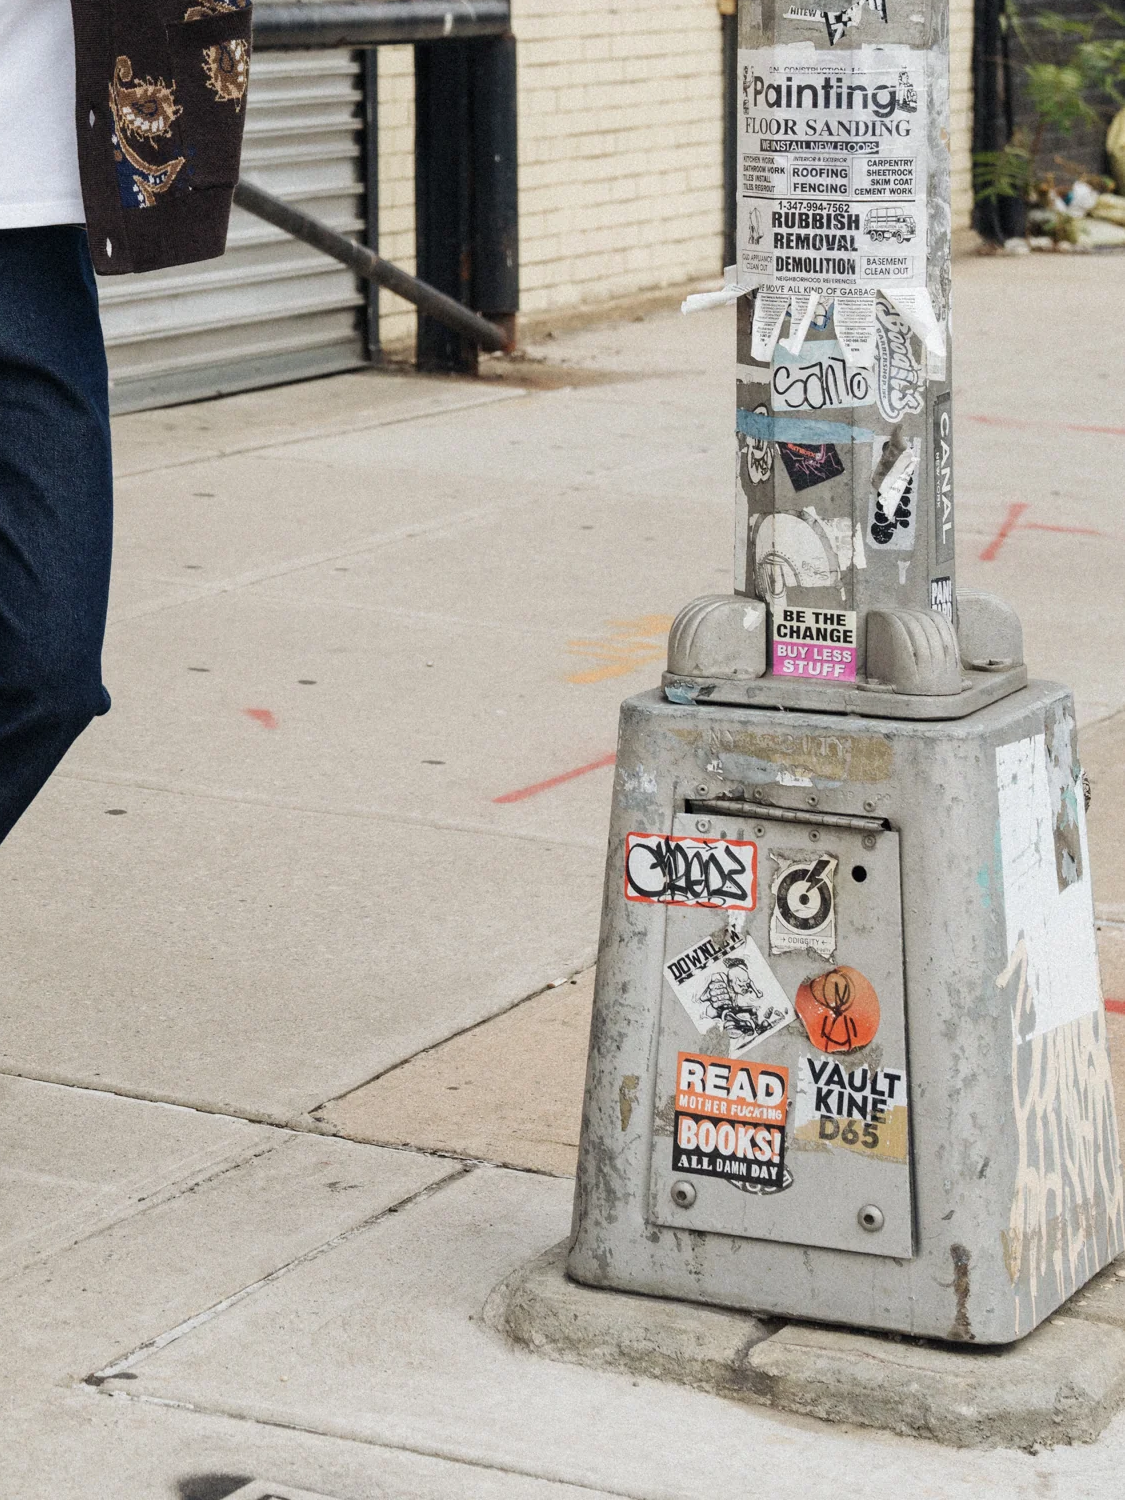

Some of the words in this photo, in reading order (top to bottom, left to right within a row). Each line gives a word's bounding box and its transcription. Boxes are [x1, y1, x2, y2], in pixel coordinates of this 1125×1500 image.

[753, 75, 897, 118] Painting
[745, 116, 798, 136] FLOOR
[804, 118, 911, 137] SANDING
[761, 140, 770, 150] WE
[771, 140, 810, 151] INSTALL
[810, 141, 835, 151] NEW
[743, 165, 766, 174] BATHROOM
[767, 166, 786, 175] WORK
[867, 159, 914, 167] CARPENTRY
[743, 174, 754, 182] TILES
[755, 174, 772, 183] INSTALL
[792, 167, 848, 179] ROOFING
[866, 168, 913, 177] SHEETROCK
[793, 182, 848, 194] FENCING
[870, 178, 891, 186] SKIM
[893, 178, 914, 186] COAT
[854, 187, 887, 196] CEMENT
[888, 187, 913, 195] WORK
[778, 200, 851, 213] 1-347-994-7562
[771, 211, 860, 231] RUBBISH
[773, 232, 859, 251] REMOVAL
[751, 253, 773, 263] APPLIANCE
[776, 256, 856, 275] DEMOLITION
[866, 257, 908, 266] BASEMENT
[775, 275, 821, 284] NEIGHBORHOOD
[822, 277, 857, 285] REFERENCES
[864, 267, 891, 276] CLEAN
[893, 267, 909, 275] OUT
[765, 284, 785, 293] MOVE
[787, 286, 802, 294] ALL
[826, 287, 837, 295] OF
[939, 411, 953, 545] CANAL
[783, 609, 806, 623] BE
[812, 611, 847, 627] THE
[776, 623, 853, 644] CHANGE
[777, 644, 809, 659] BUY
[813, 647, 852, 663] LESS
[782, 659, 846, 678] STUFF
[787, 936, 820, 946] ODIGGITY
[667, 924, 741, 981] DOWNLW
[679, 1057, 786, 1107] READ
[807, 1057, 902, 1099] VAULT
[678, 1093, 728, 1115] MOTHER
[730, 1104, 783, 1121] FUCKING
[815, 1086, 888, 1124] KINE
[677, 1115, 782, 1164] BOOKS!
[818, 1113, 880, 1149] D65
[677, 1154, 713, 1171] ALL
[716, 1158, 748, 1176] DAMN
[751, 1164, 779, 1180] DAY
